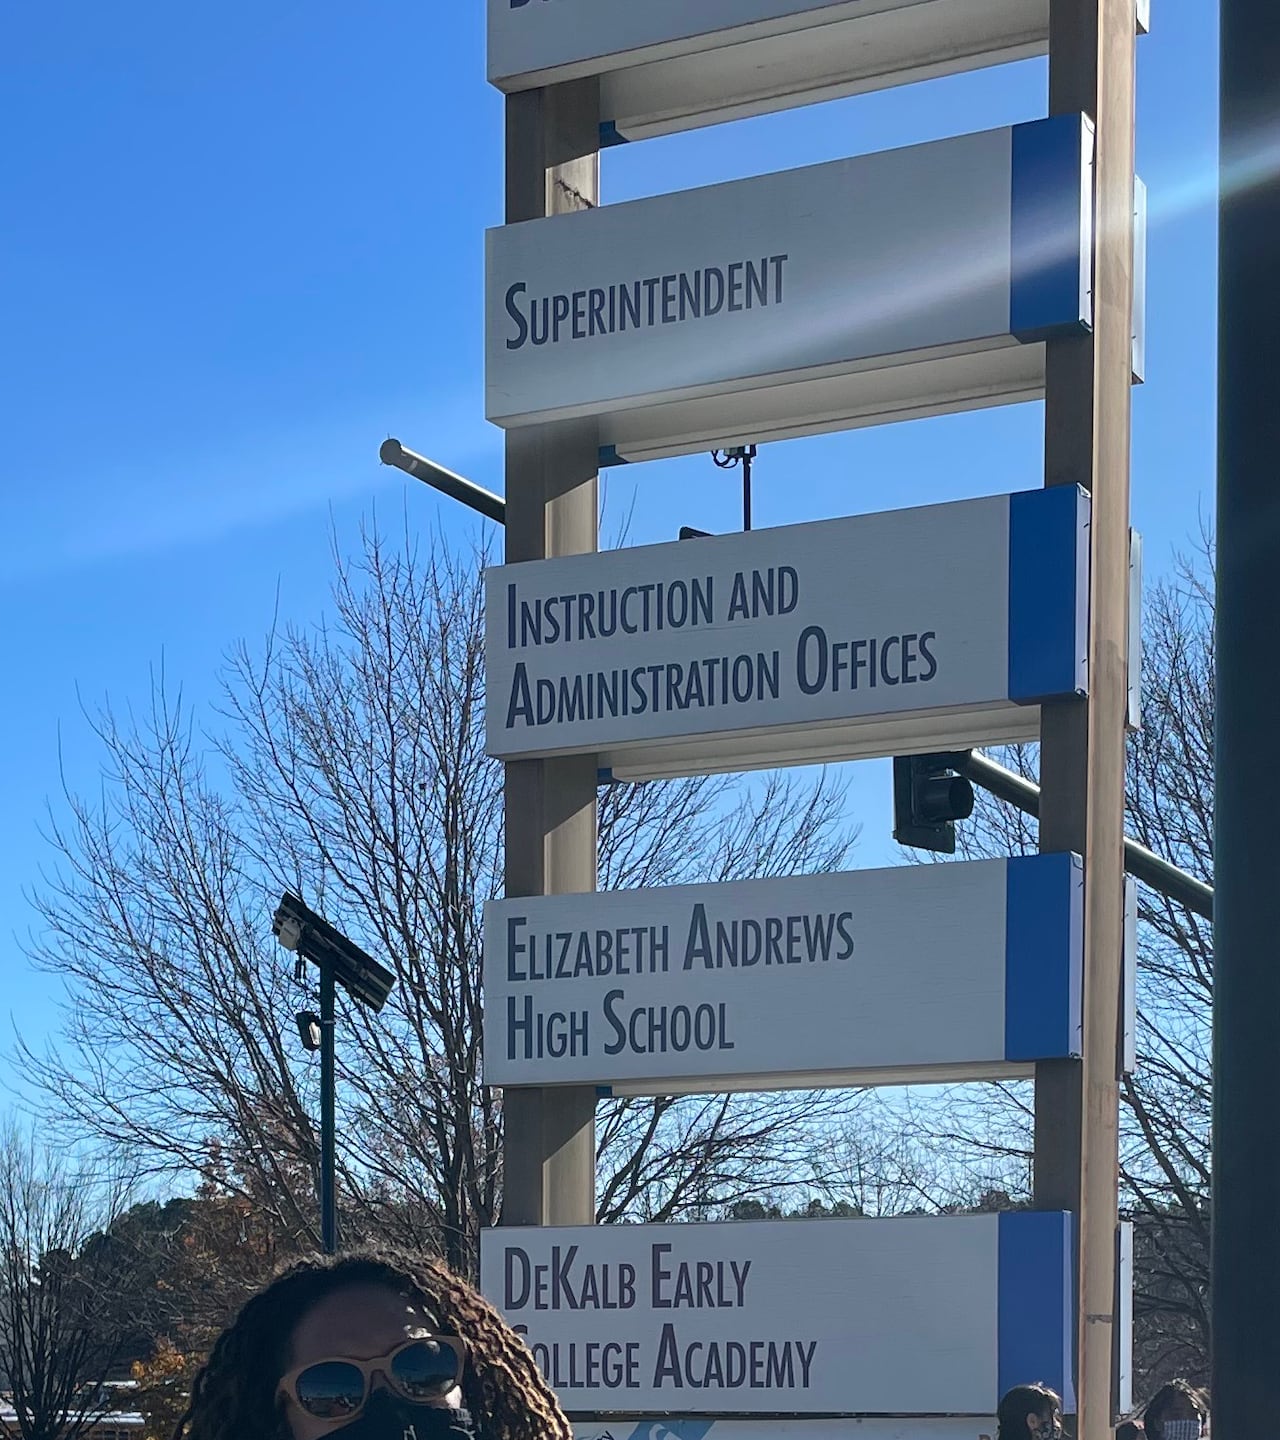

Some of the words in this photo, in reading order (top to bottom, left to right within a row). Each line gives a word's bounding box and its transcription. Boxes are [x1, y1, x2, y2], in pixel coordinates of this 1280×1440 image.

[505, 254, 788, 350] SUPERINTENDENT
[507, 576, 713, 649] INSTRUCTION
[728, 565, 799, 620] AND
[506, 650, 780, 729] ADMINISTRATION
[796, 626, 938, 695] OFFICES
[507, 917, 669, 982] ELIZABETH
[682, 903, 854, 970] ANDREWS
[506, 995, 589, 1060] HIGH
[603, 989, 734, 1055] SCHOOL
[651, 1243, 751, 1309] EARLY
[512, 1325, 640, 1389] OLLEGE
[653, 1323, 817, 1389] ACADEMY
